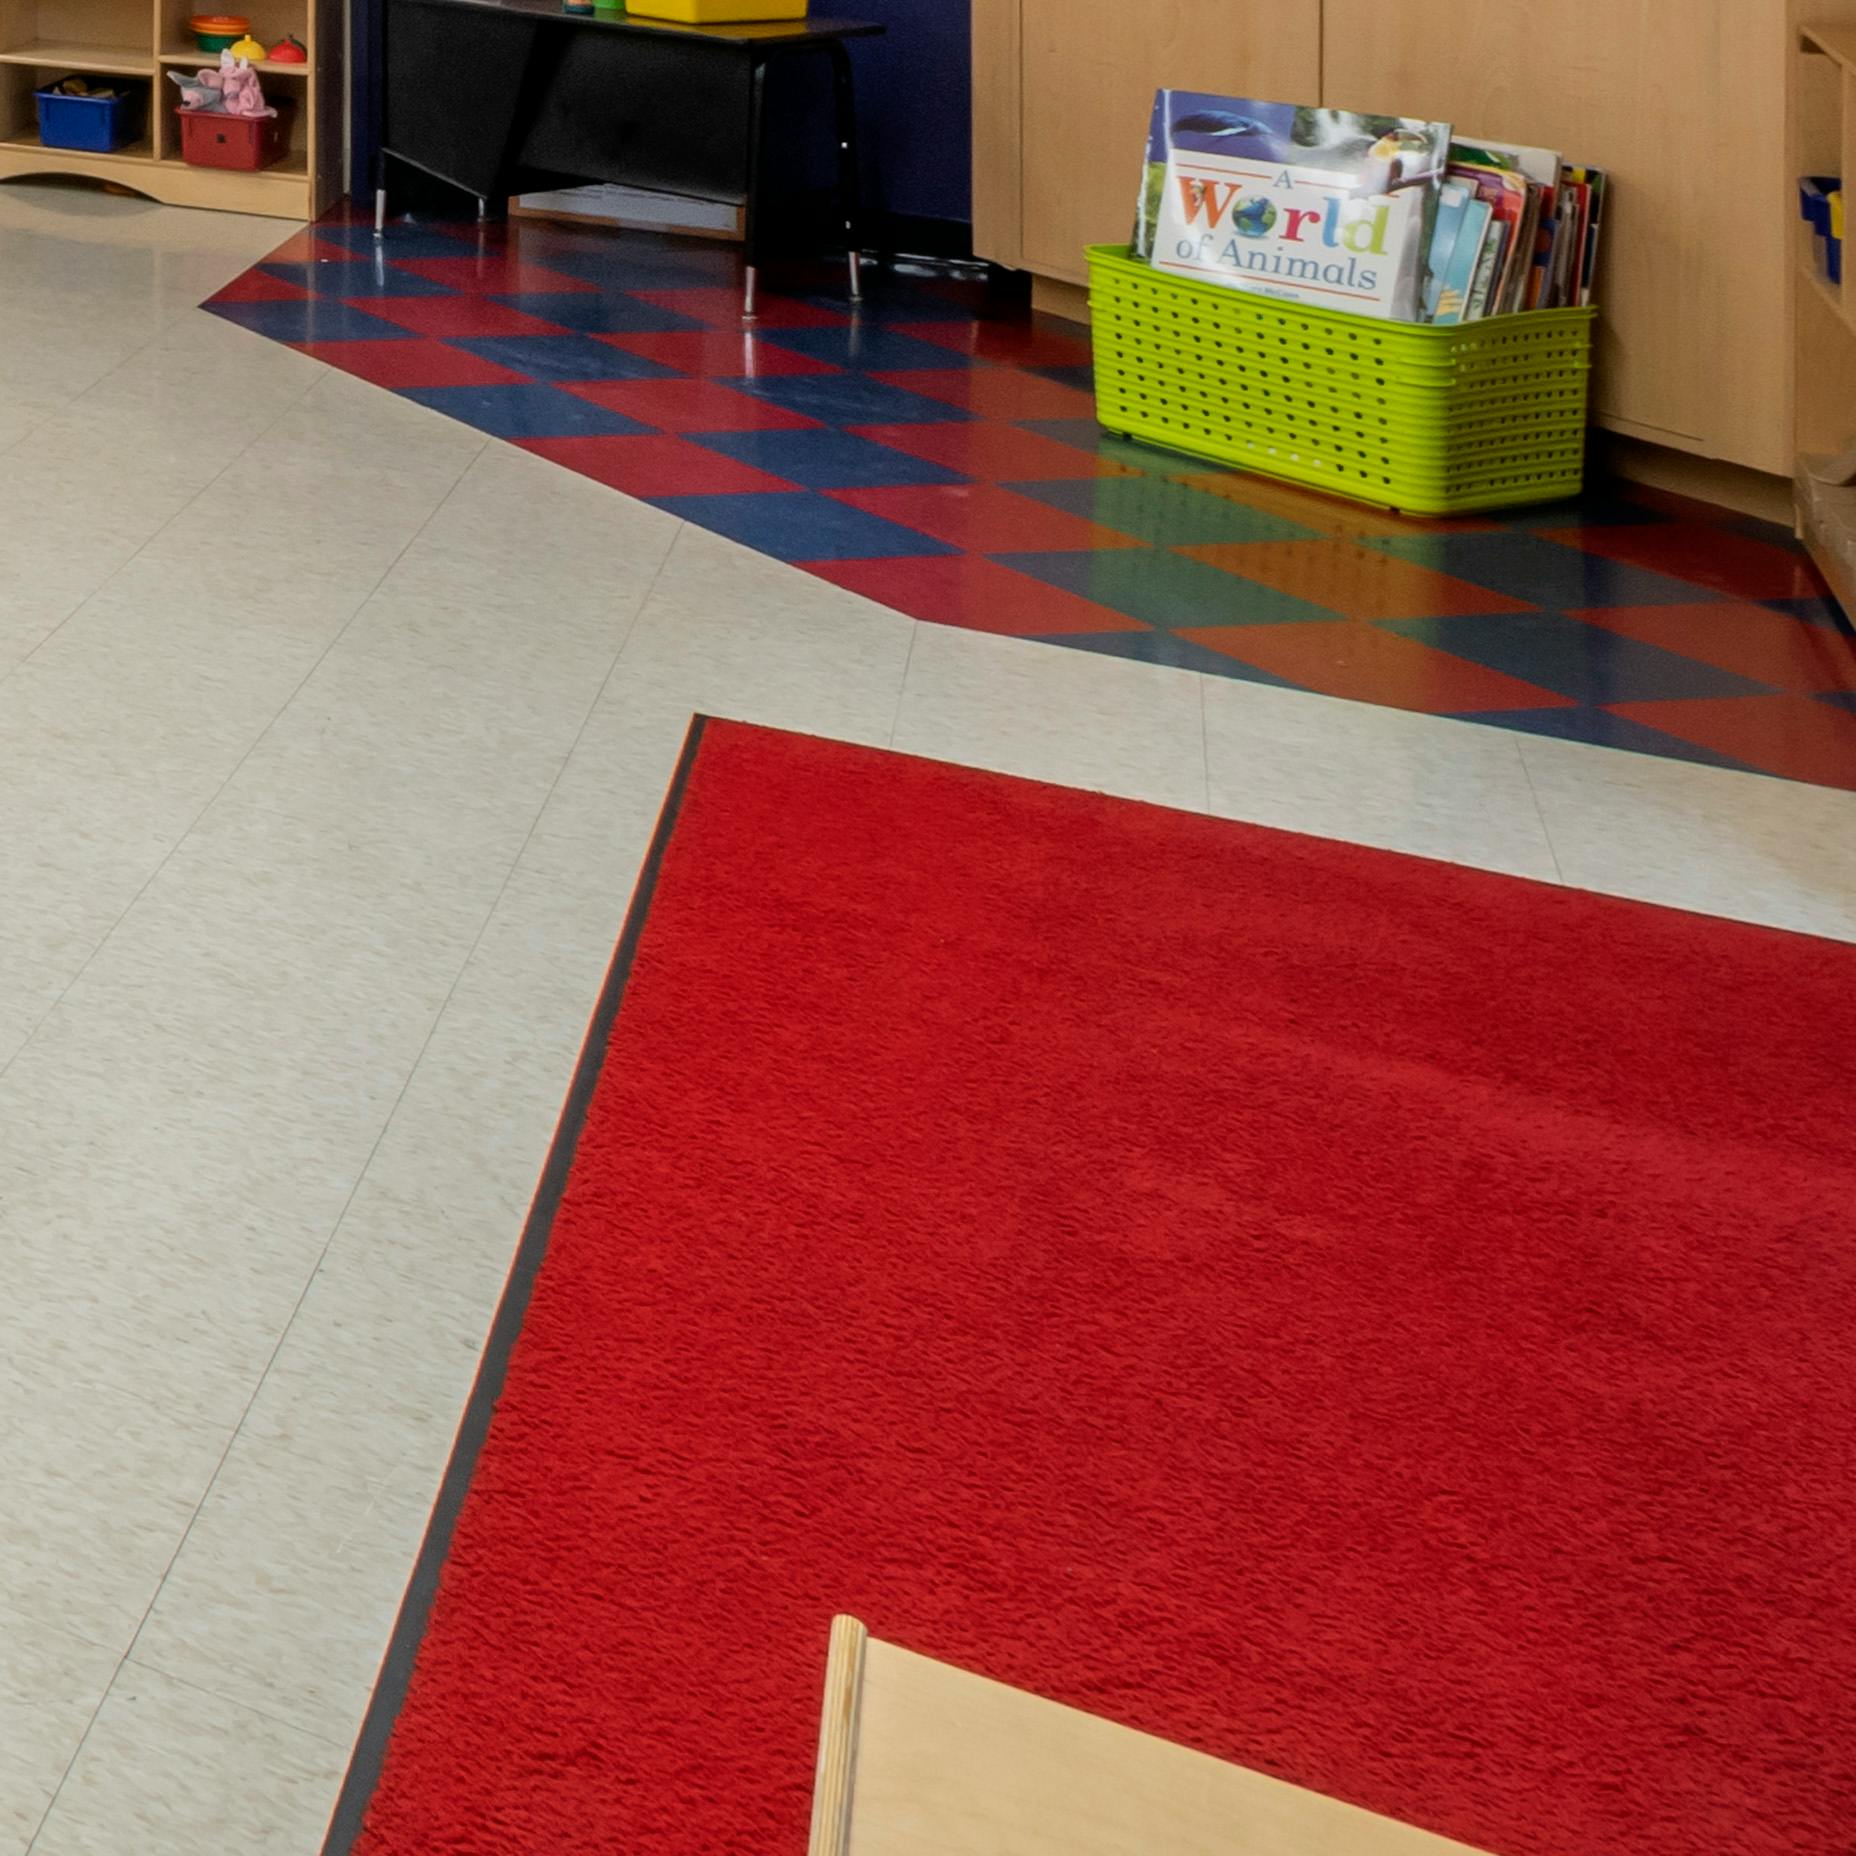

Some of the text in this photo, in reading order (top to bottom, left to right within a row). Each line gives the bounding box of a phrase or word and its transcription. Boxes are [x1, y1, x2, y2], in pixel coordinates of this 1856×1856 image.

[1273, 169, 1295, 190] A
[1175, 233, 1378, 291] of Animals
